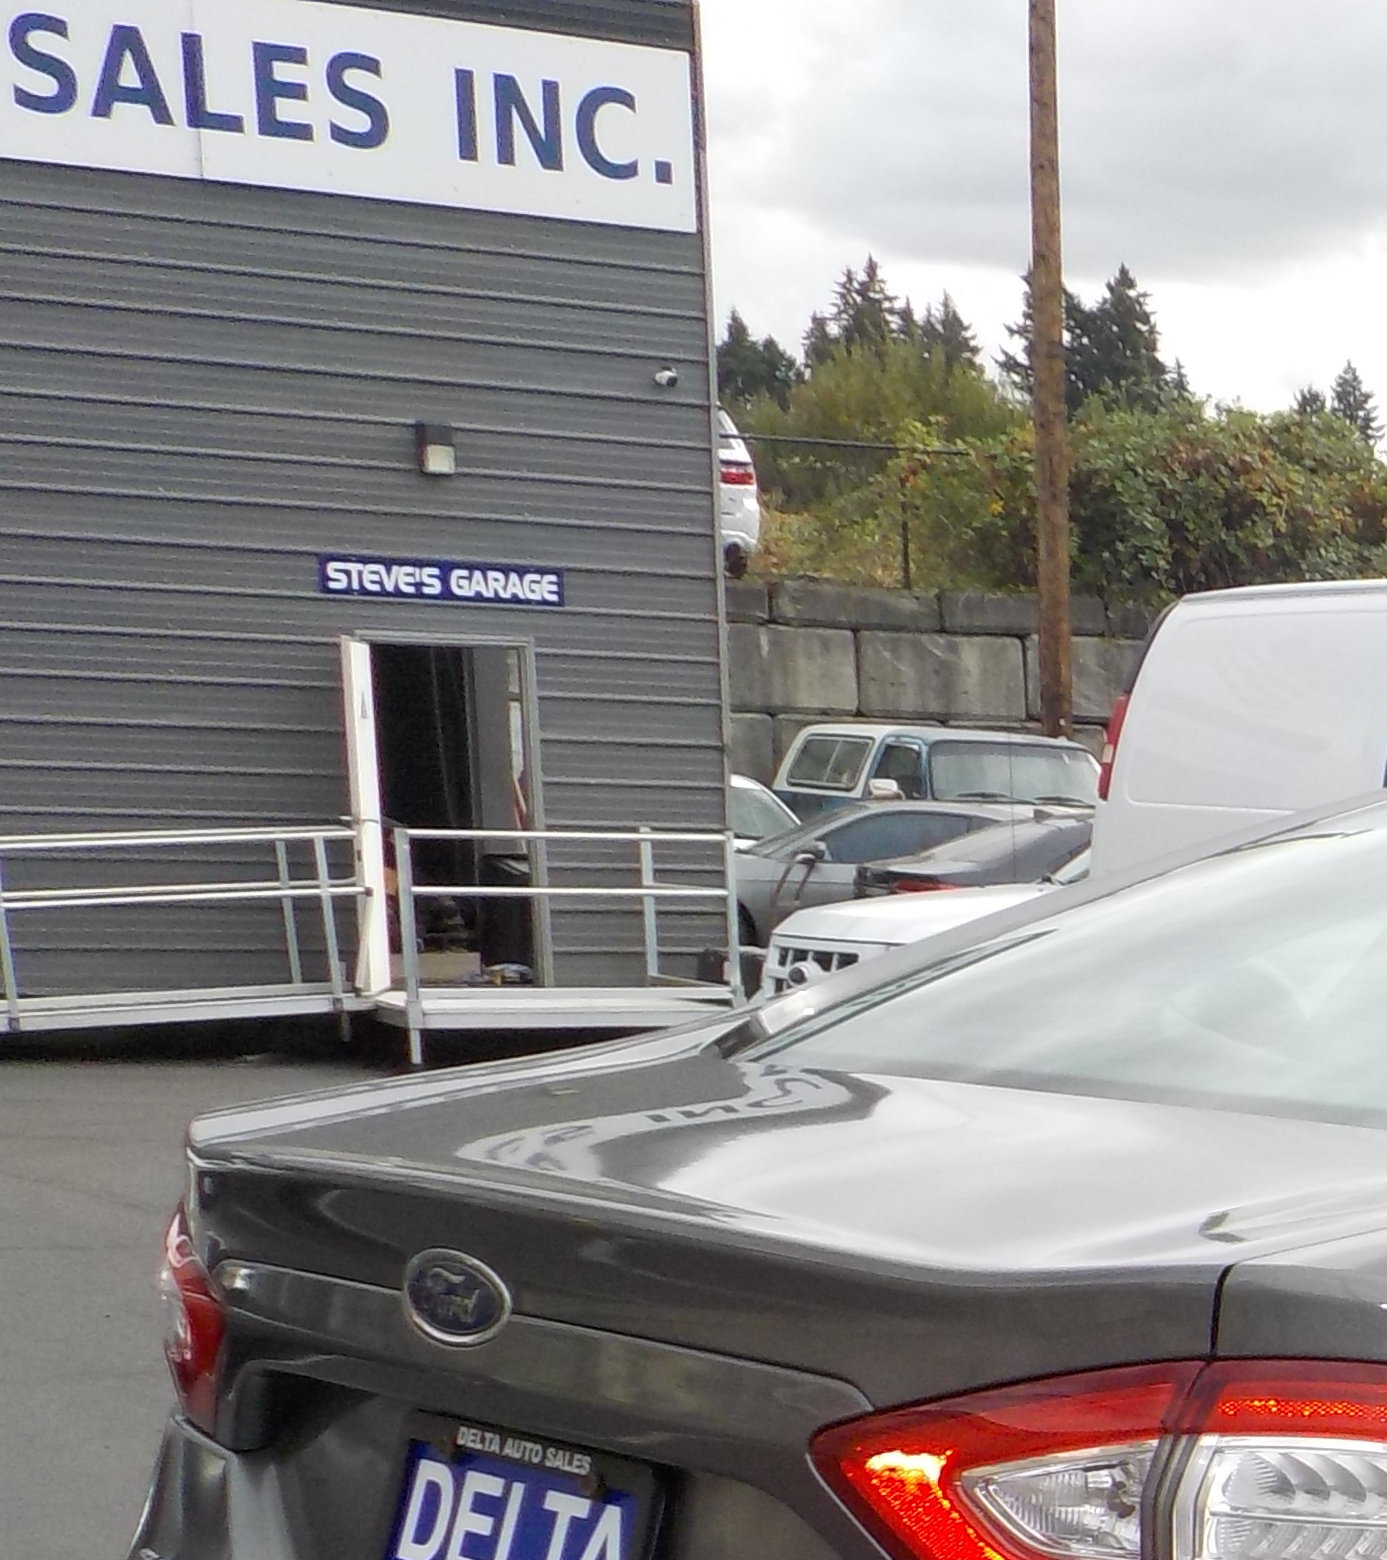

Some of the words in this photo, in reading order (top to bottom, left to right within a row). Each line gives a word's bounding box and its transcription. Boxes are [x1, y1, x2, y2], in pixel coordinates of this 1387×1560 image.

[6, 12, 390, 149] SALES
[454, 66, 673, 186] INC.
[326, 561, 442, 595] STEVE'S
[450, 569, 559, 601] GARAGE
[456, 1426, 501, 1455] DELTA
[501, 1437, 543, 1463] AUTO
[544, 1447, 592, 1475] SALES
